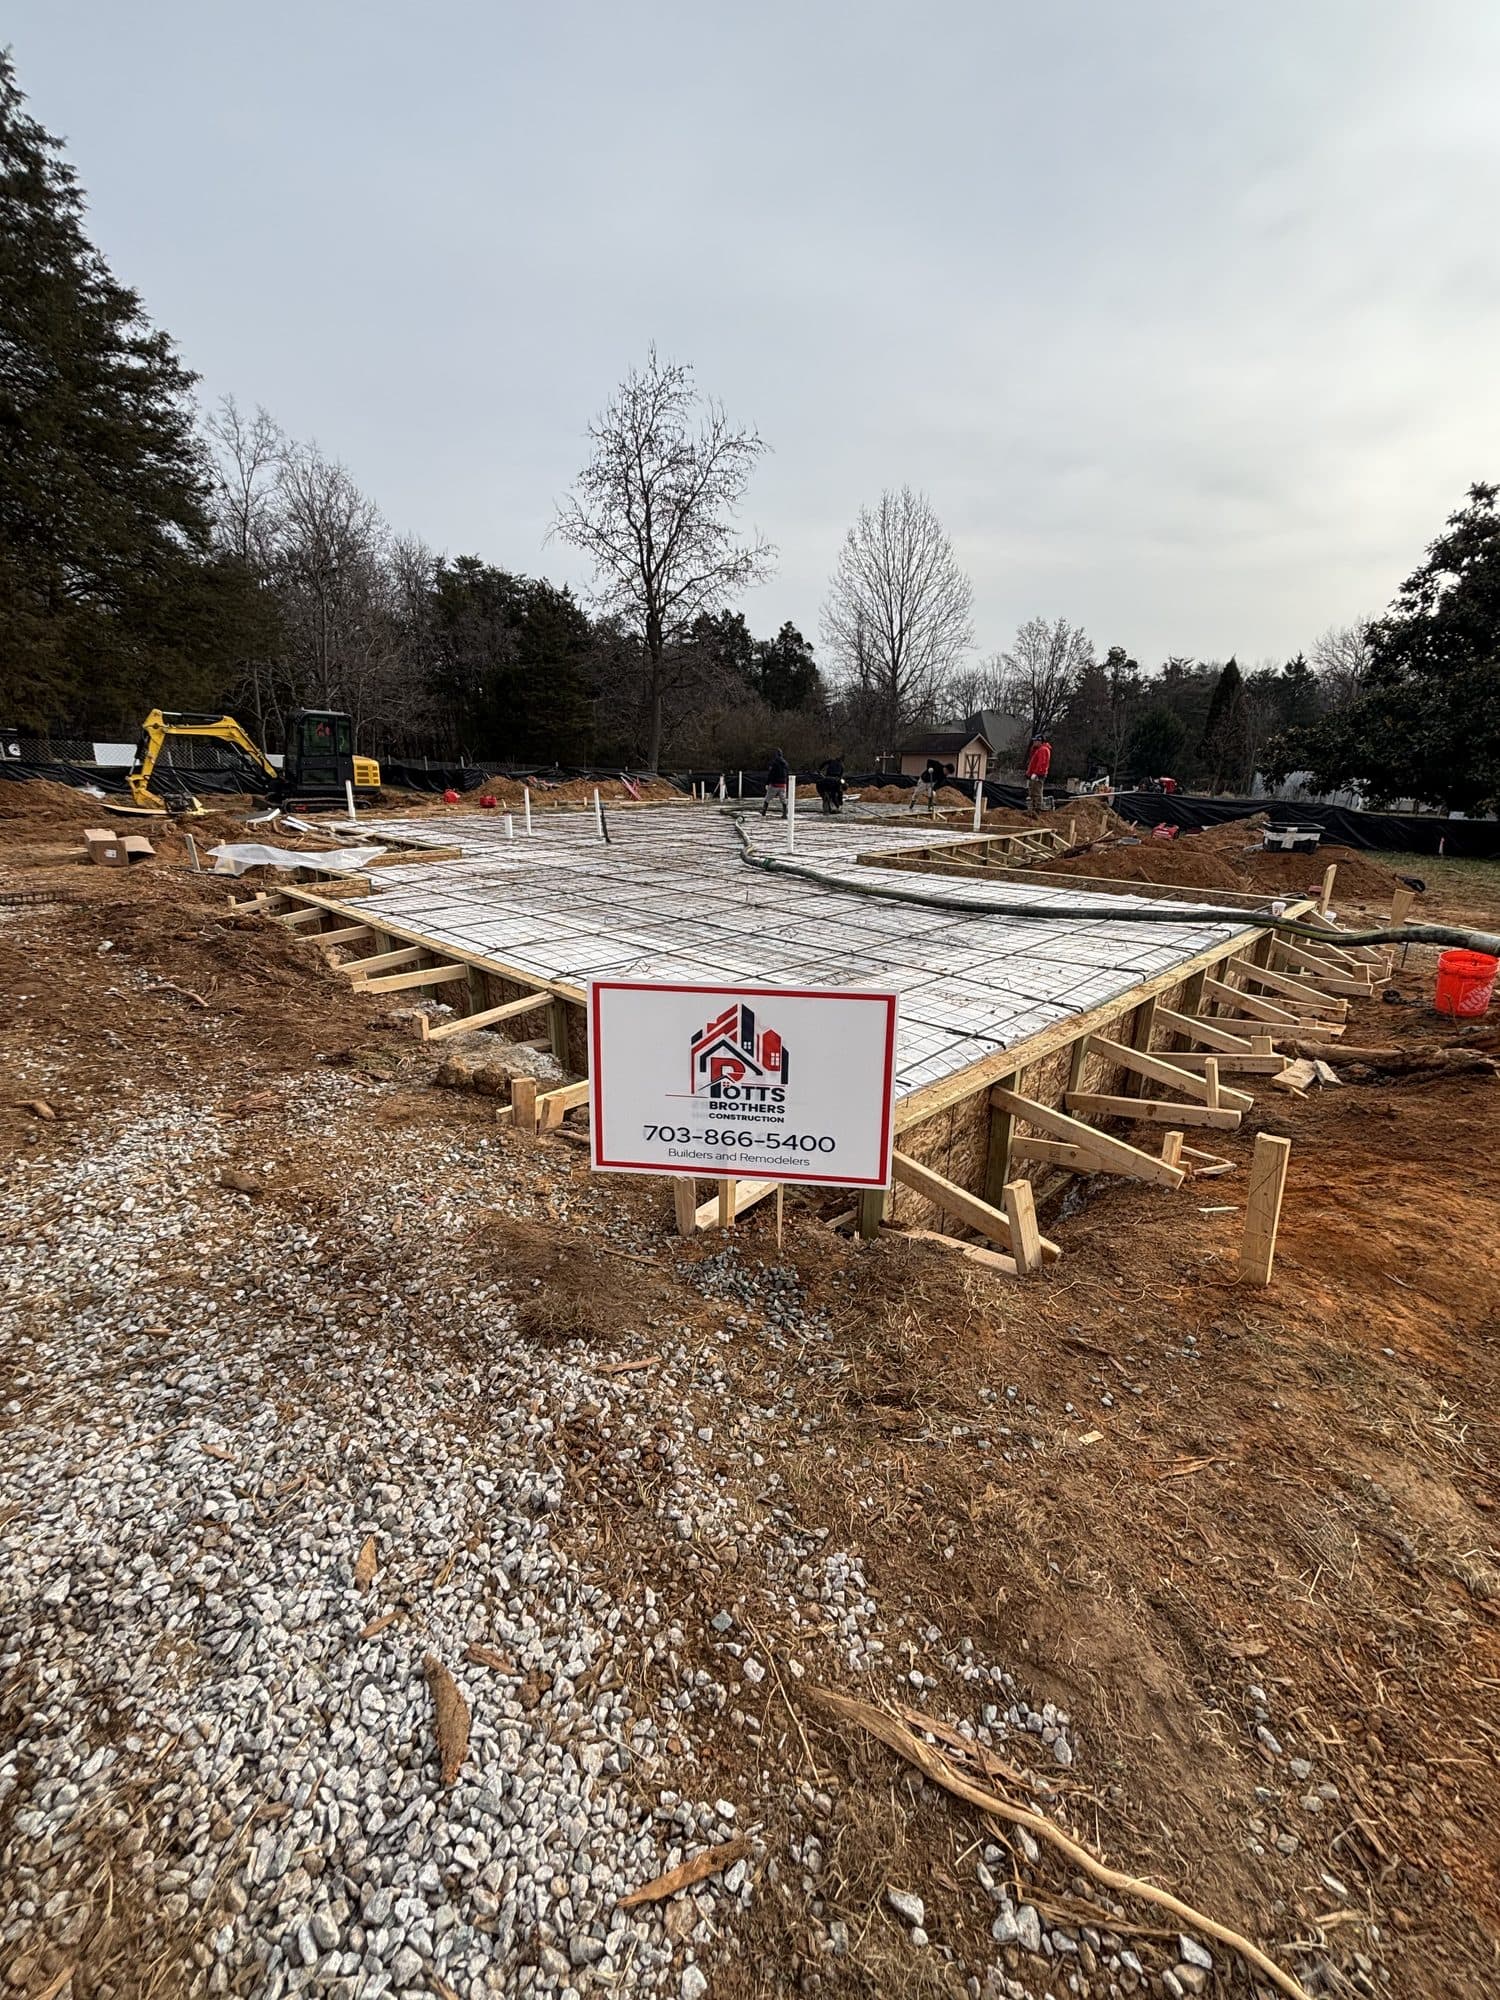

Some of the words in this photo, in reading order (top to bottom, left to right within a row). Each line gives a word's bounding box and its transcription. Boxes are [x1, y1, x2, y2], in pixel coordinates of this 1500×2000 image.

[710, 1057, 785, 1102] POTTS
[709, 1101, 785, 1114] BROTHERS
[708, 1112, 785, 1123] CONSTRUCTION
[643, 1125, 836, 1153] 703-866-5400
[668, 1148, 713, 1160] Builders
[715, 1152, 737, 1162] and
[739, 1153, 810, 1167] Remodelers
